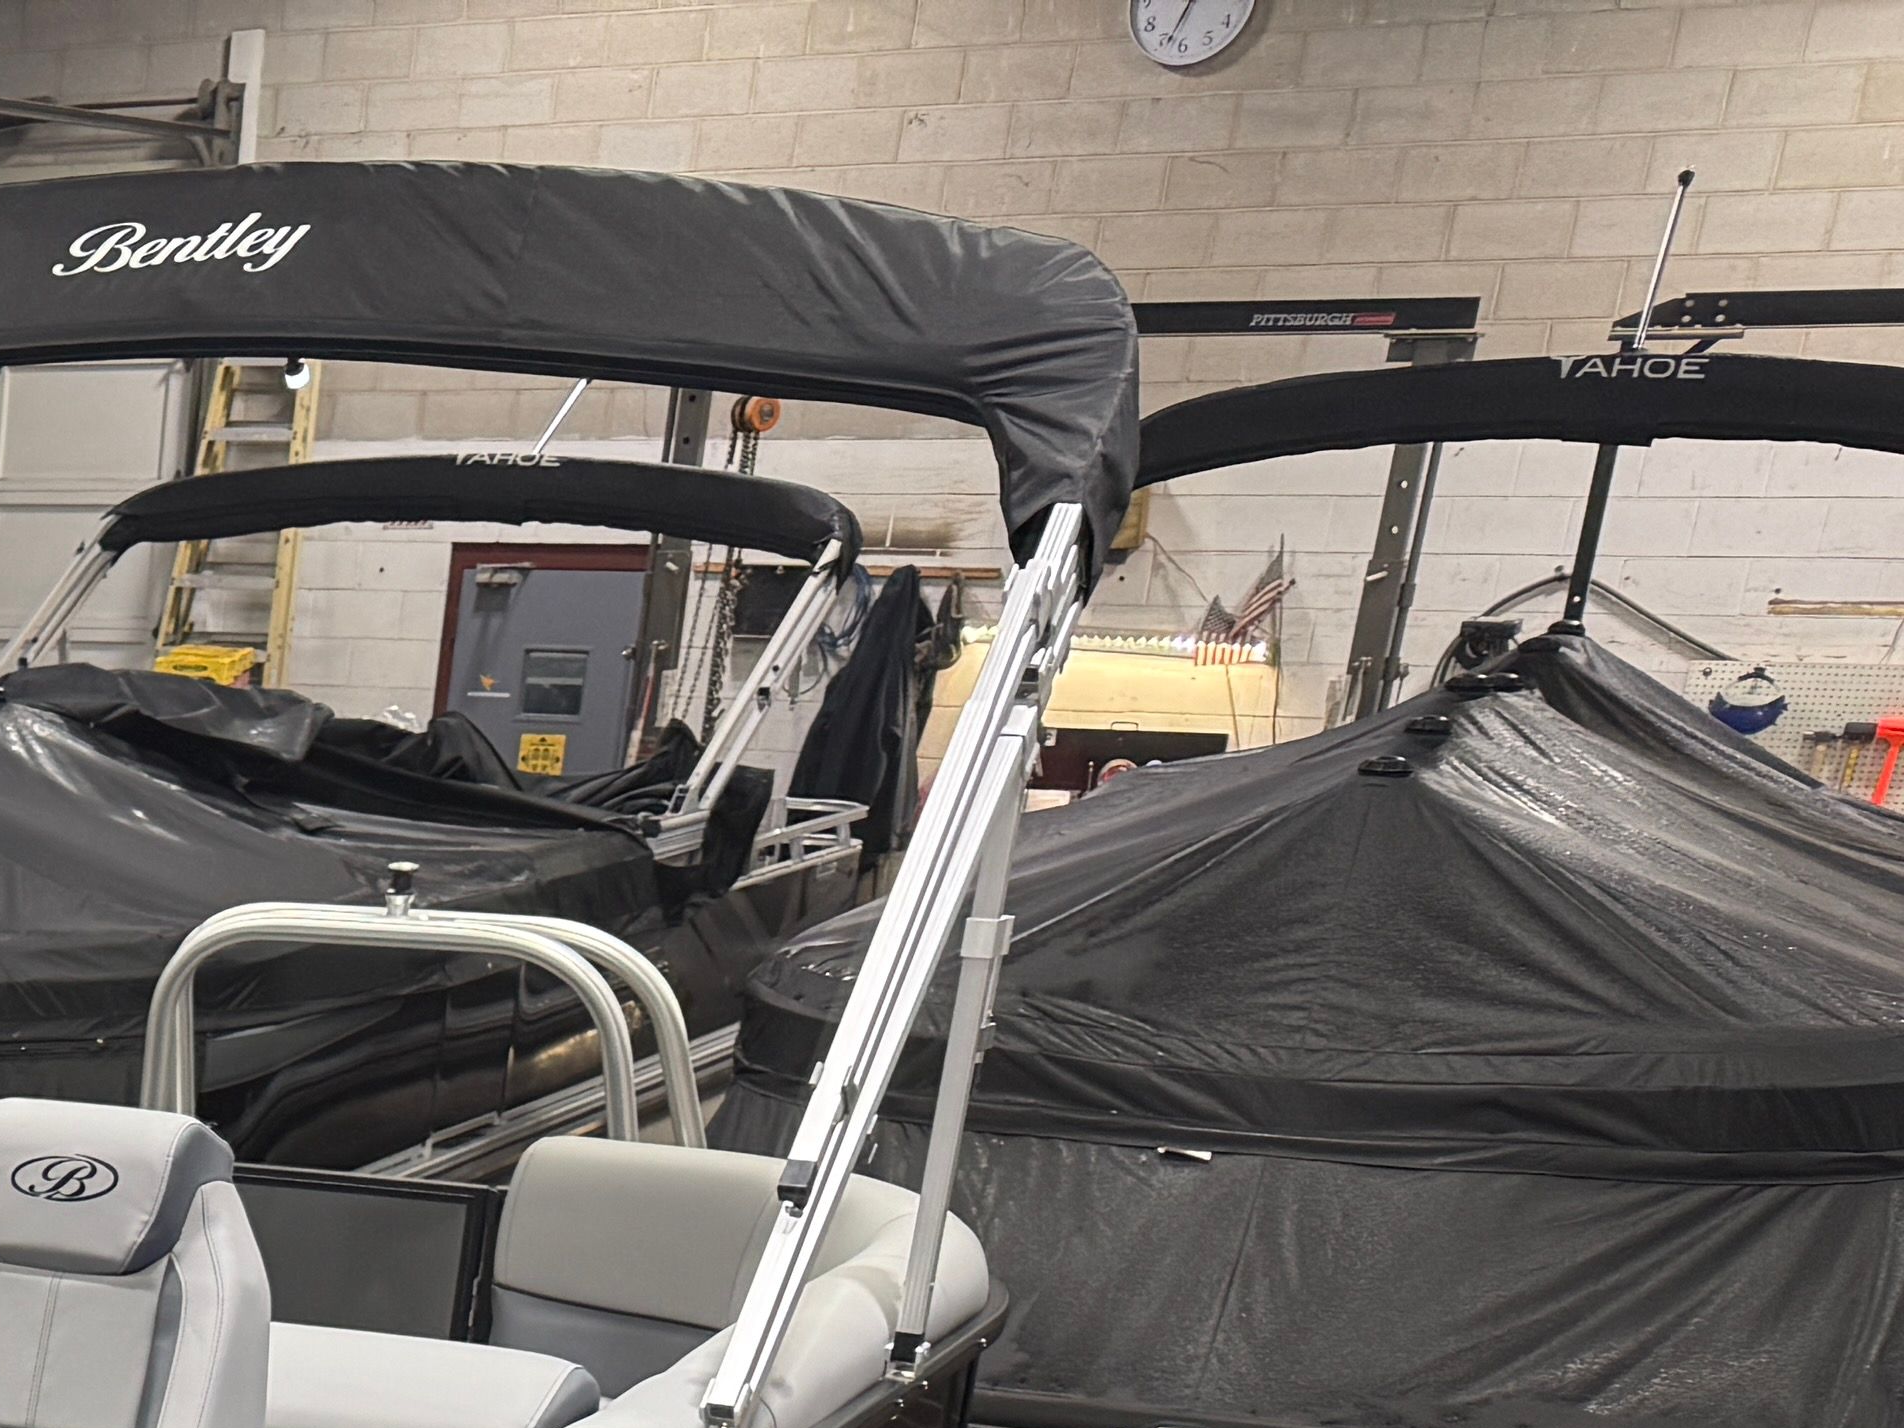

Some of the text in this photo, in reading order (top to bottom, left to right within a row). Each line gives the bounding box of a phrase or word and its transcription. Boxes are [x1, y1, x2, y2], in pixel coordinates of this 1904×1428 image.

[51, 212, 311, 276] Bentley
[1249, 313, 1354, 327] PITTSBURGH
[1550, 354, 1711, 380] TAHOE
